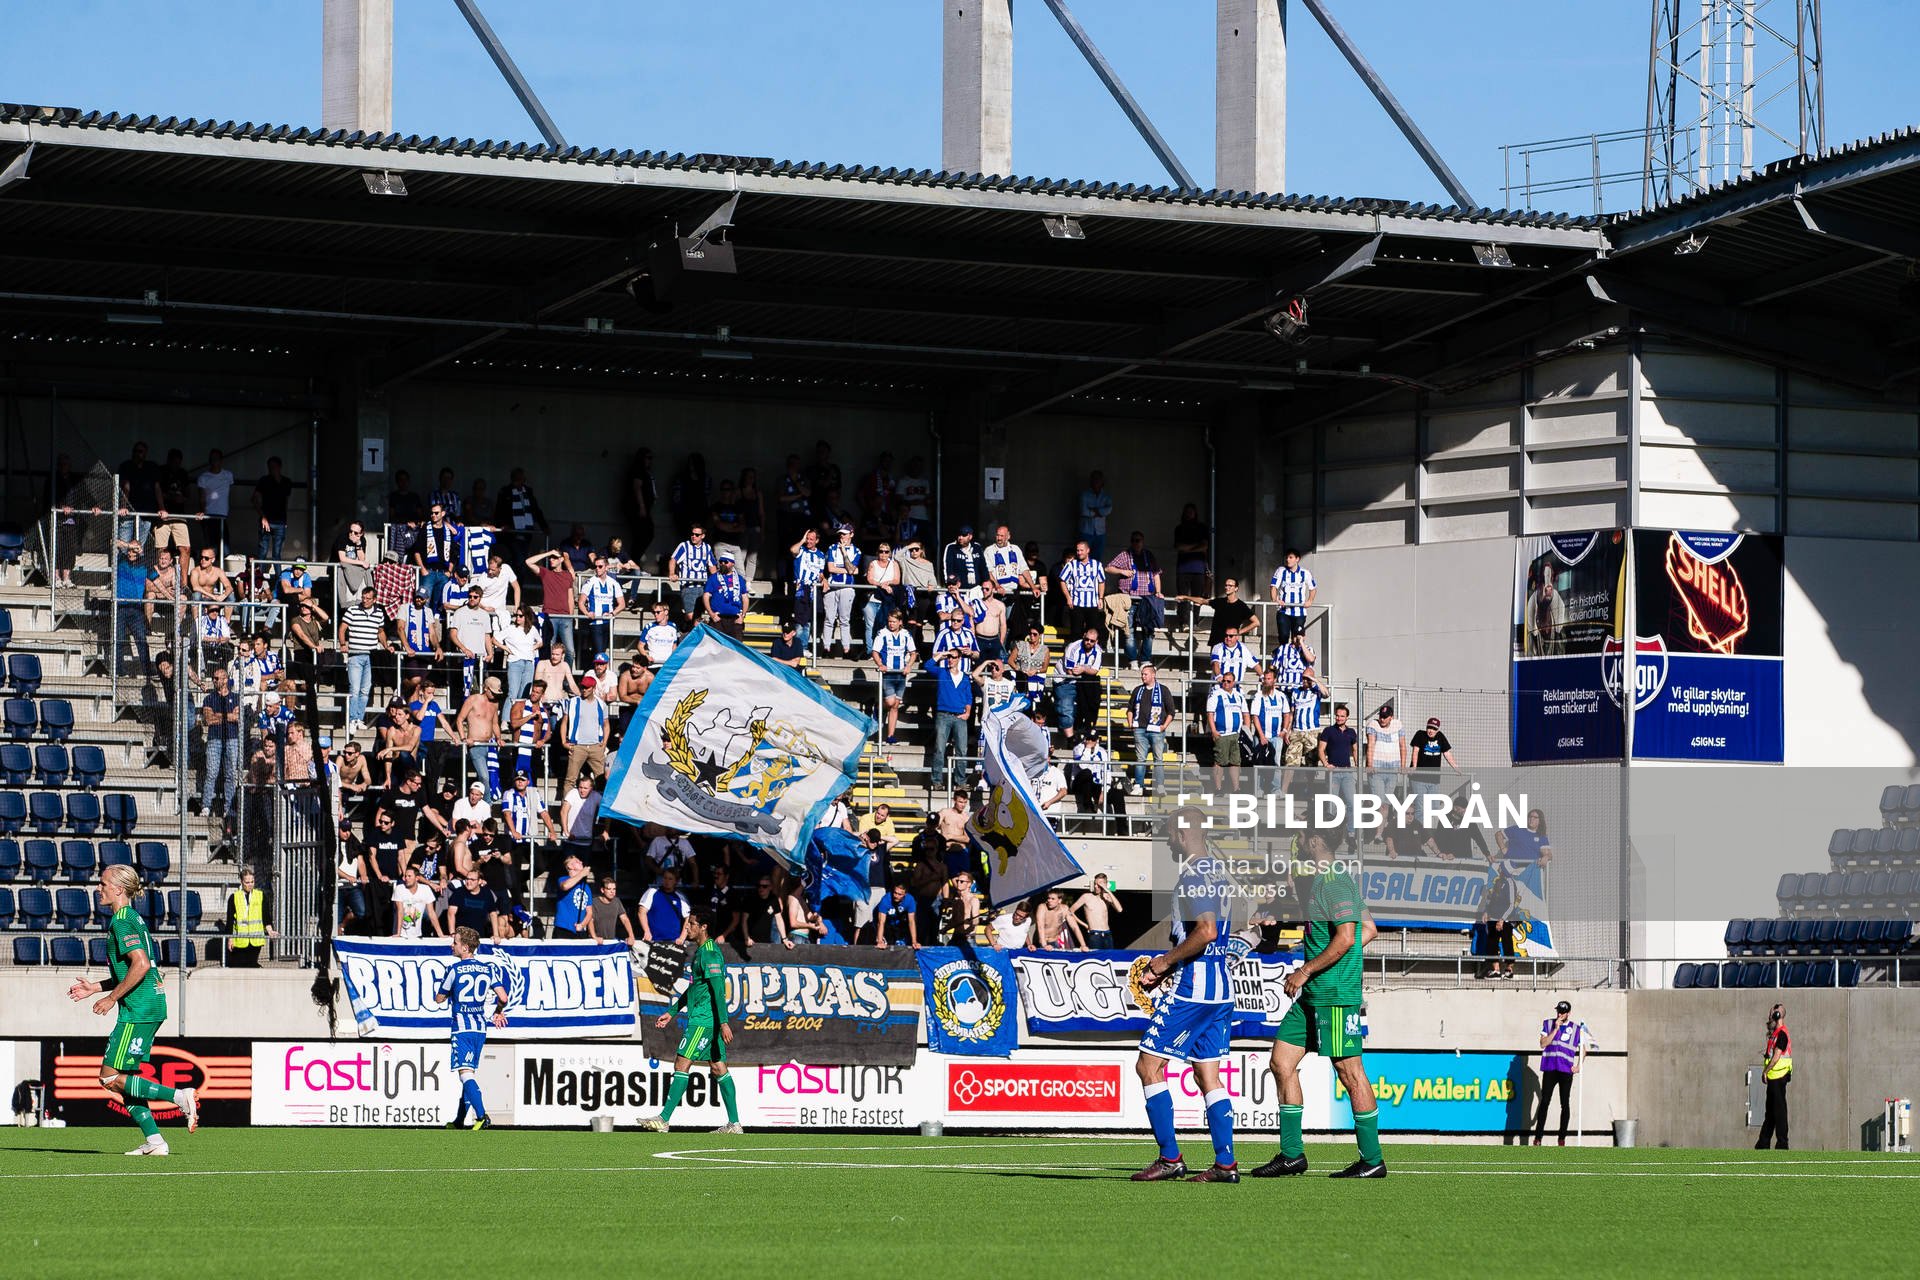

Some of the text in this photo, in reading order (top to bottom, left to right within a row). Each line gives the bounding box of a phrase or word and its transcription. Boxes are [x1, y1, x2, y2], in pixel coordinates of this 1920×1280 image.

[367, 447, 379, 465] T
[989, 477, 1000, 493] T
[1677, 548, 1742, 622] SHELL
[1569, 590, 1609, 609] En historisk
[1543, 688, 1600, 702] Reklamplatser,
[1671, 686, 1746, 703] Vi gillar skyltar
[1543, 701, 1598, 715] som sticker ut!
[1667, 701, 1750, 718] med upplysning!
[1557, 736, 1584, 748] 4SIGN.SE
[1691, 736, 1726, 748] 4SIGN.SE
[456, 963, 490, 974] SERNEKE
[458, 973, 492, 1003] 20
[743, 1015, 824, 1031] Sedan 2004
[559, 1055, 624, 1067] gestrike
[285, 1045, 440, 1099] Fastlink
[1412, 1076, 1480, 1101] Måleri
[1486, 1079, 1515, 1101] AB
[329, 1104, 440, 1124] Be The Fastest
[800, 1107, 904, 1125] Be The Fastest
